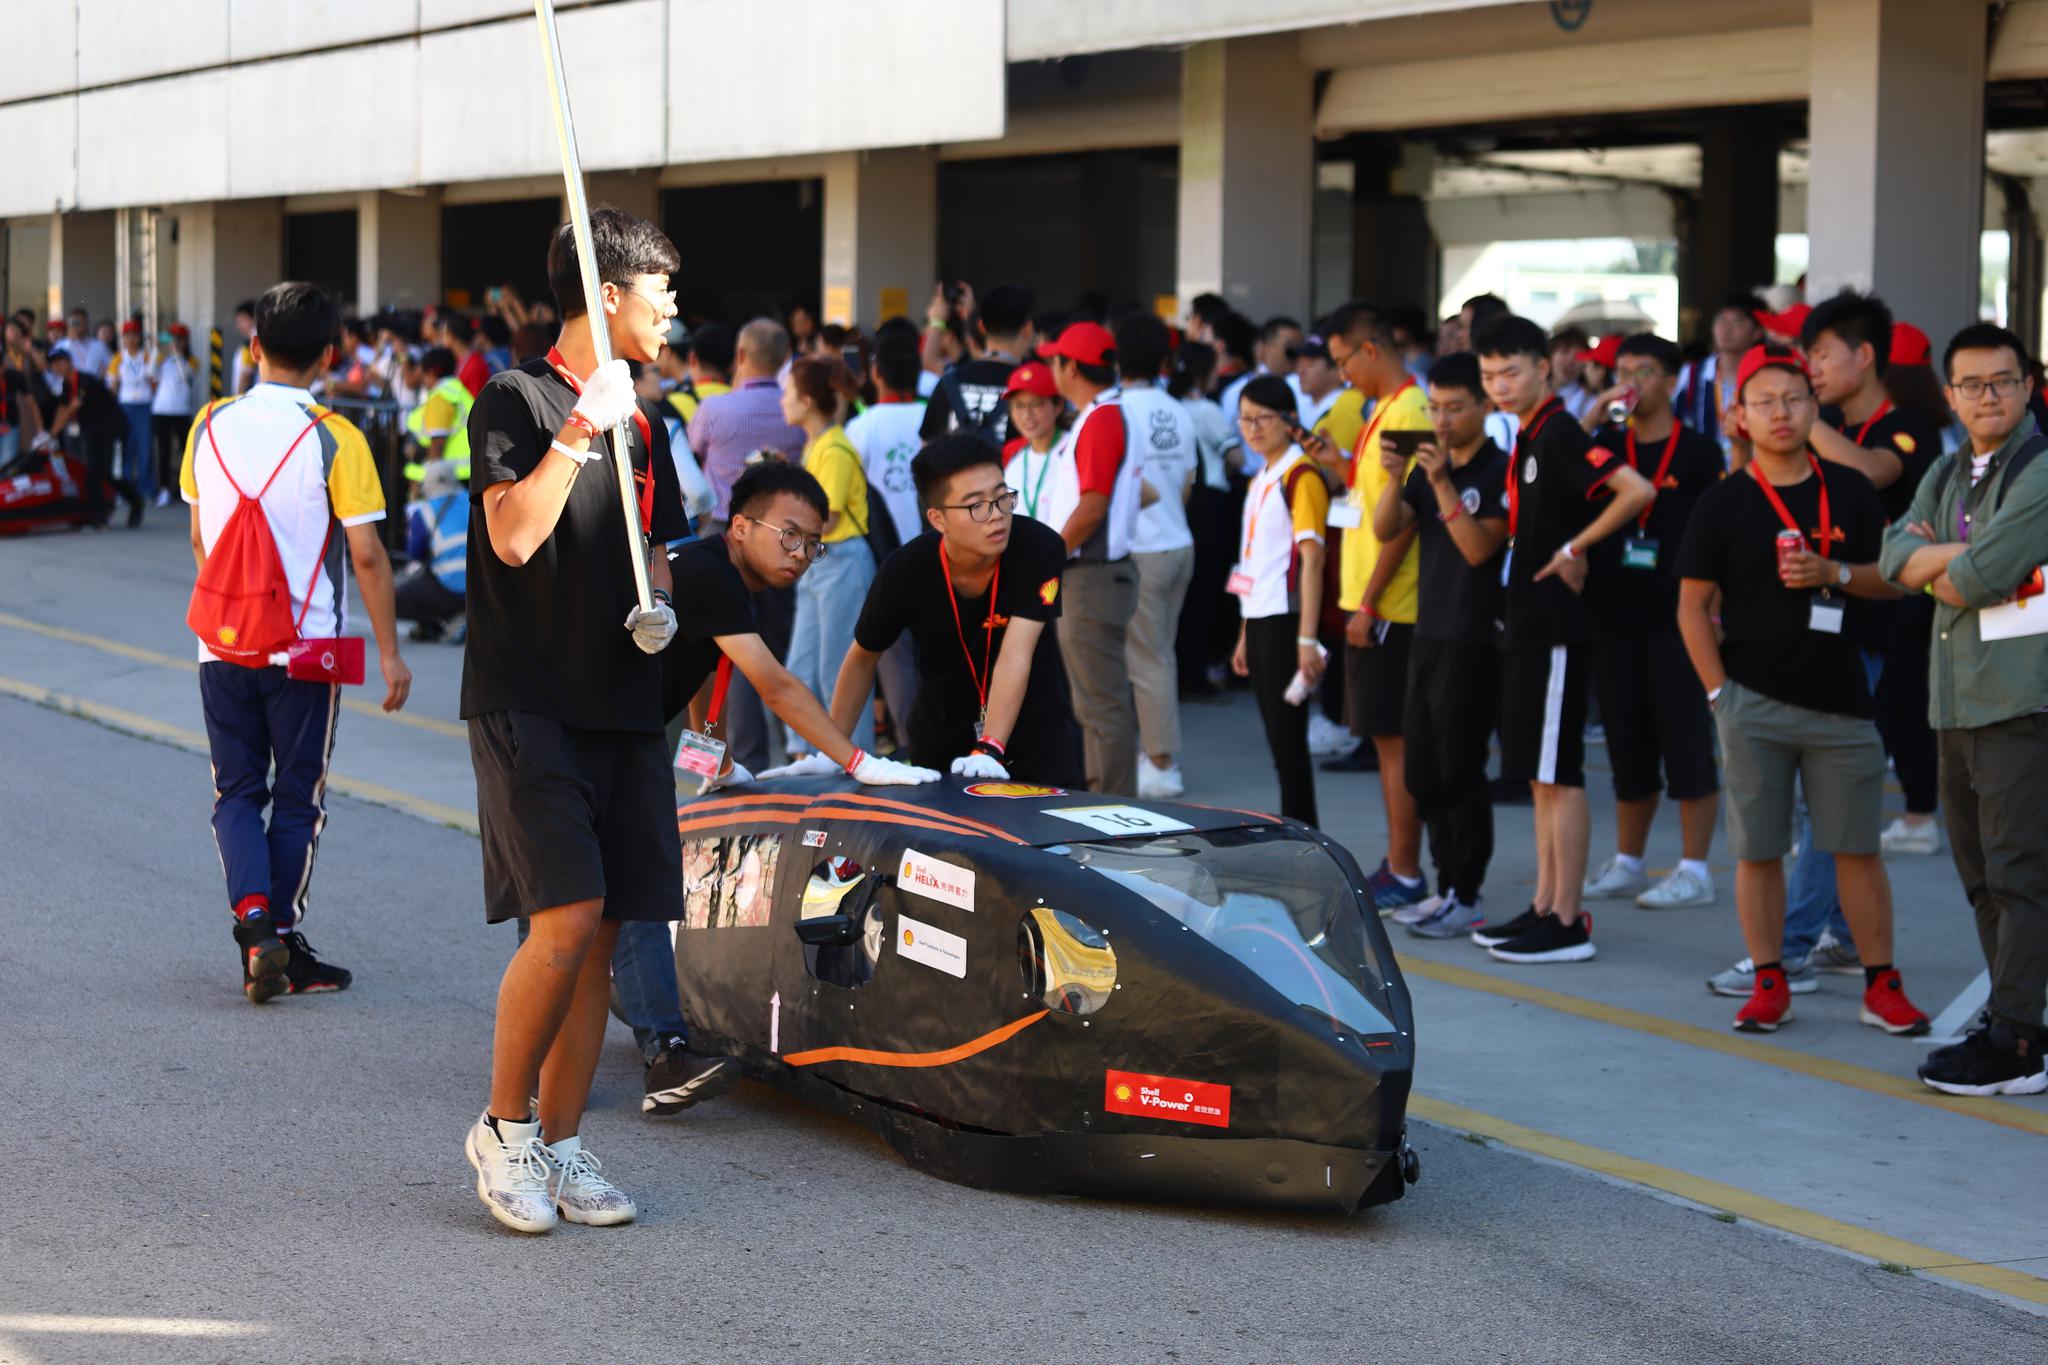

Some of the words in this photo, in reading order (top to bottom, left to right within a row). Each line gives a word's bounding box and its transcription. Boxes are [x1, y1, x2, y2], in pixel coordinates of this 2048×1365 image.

[1090, 813, 1152, 828] 16
[915, 872, 940, 889] HELIX
[1140, 1086, 1160, 1096] Shell
[1140, 1095, 1190, 1111] V-Power
